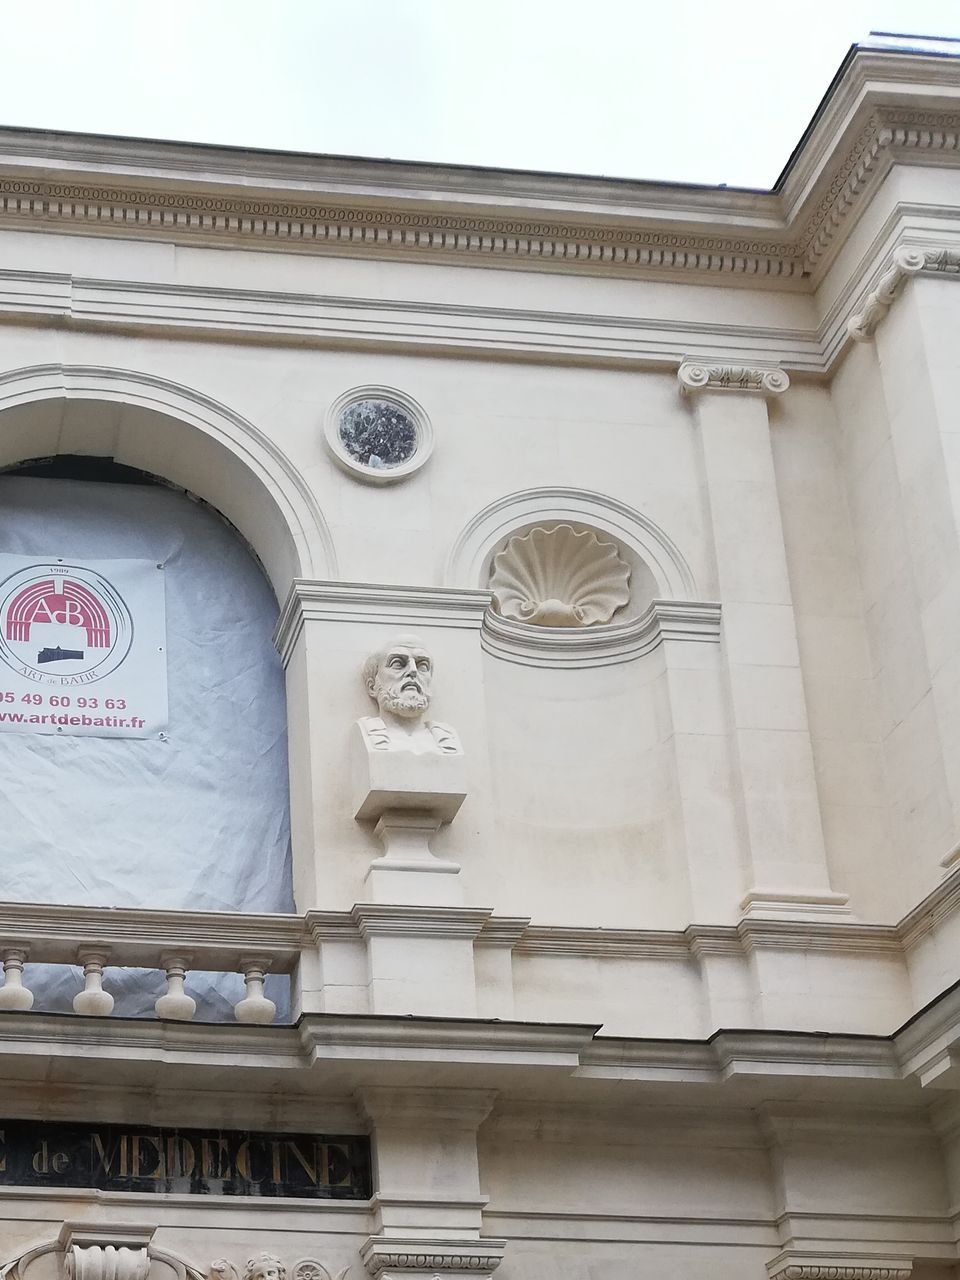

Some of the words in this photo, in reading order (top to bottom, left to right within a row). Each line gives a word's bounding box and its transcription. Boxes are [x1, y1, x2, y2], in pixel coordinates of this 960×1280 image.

[19, 666, 46, 682] ART
[21, 694, 43, 706] 49
[49, 696, 71, 708] 60
[77, 698, 99, 710] 93
[105, 699, 127, 710] 63
[32, 1138, 70, 1174] de
[90, 1133, 352, 1188] MEDECINE
